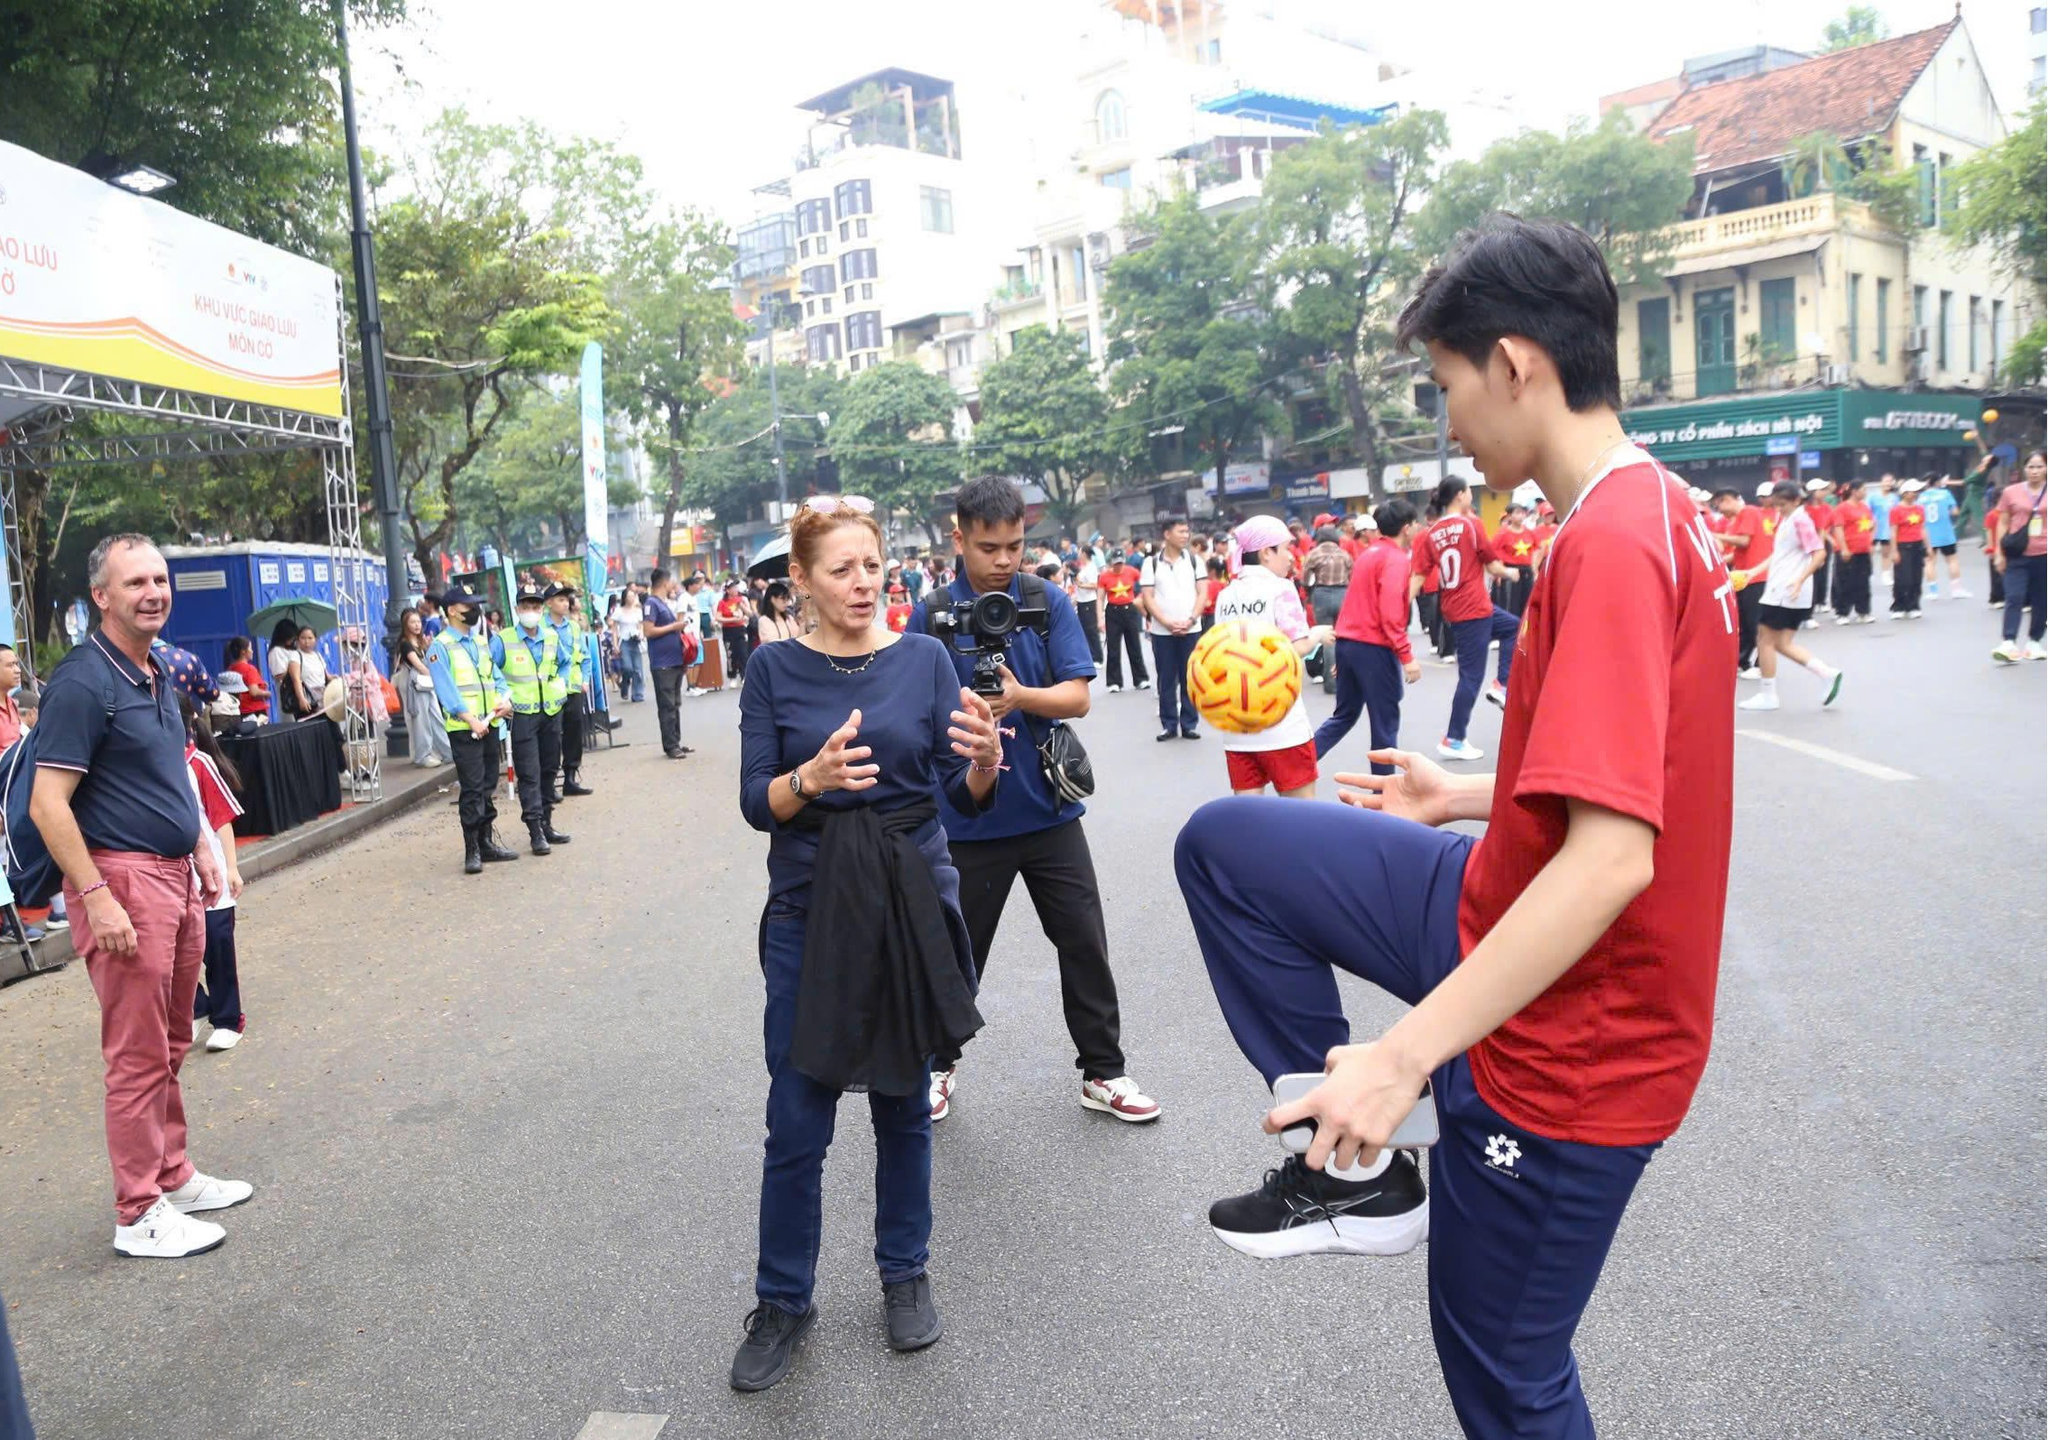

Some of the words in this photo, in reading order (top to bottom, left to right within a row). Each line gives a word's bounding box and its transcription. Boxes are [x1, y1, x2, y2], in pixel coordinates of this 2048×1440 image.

[23, 241, 57, 271] LƯU
[194, 294, 220, 317] KHU
[249, 310, 275, 333] GIAO
[228, 332, 255, 354] MÔN
[1630, 430, 1658, 445] ÔNG
[1660, 430, 1676, 443] TY
[1735, 419, 1770, 437] SÁCH
